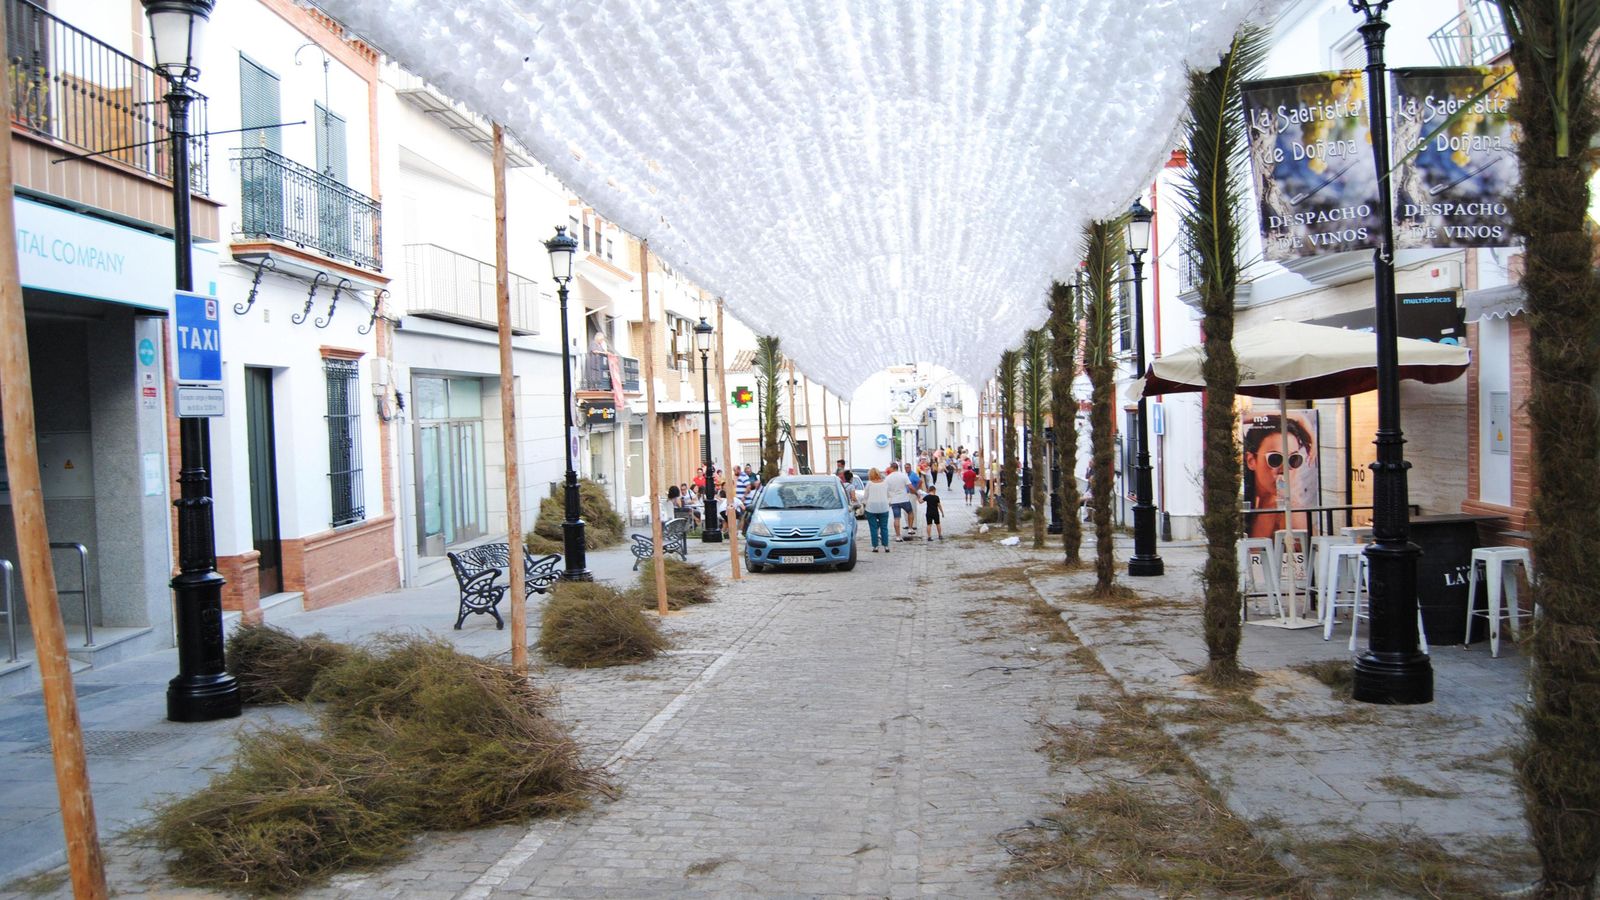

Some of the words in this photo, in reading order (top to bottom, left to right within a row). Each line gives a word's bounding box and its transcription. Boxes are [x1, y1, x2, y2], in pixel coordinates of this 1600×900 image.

[1398, 95, 1416, 121] La
[1250, 108, 1270, 134] La
[1263, 146, 1284, 164] de
[1292, 140, 1357, 160] Doñana
[1436, 132, 1501, 155] Doñana
[1269, 204, 1370, 229] DESPACHO
[1404, 203, 1507, 217] DESPACHO
[1279, 236, 1303, 249] DE
[1308, 227, 1368, 247] VINOS
[1412, 226, 1437, 239] DE
[1443, 225, 1502, 239] VINOS
[52, 239, 125, 274] COMPANY
[178, 325, 219, 351] TAXI
